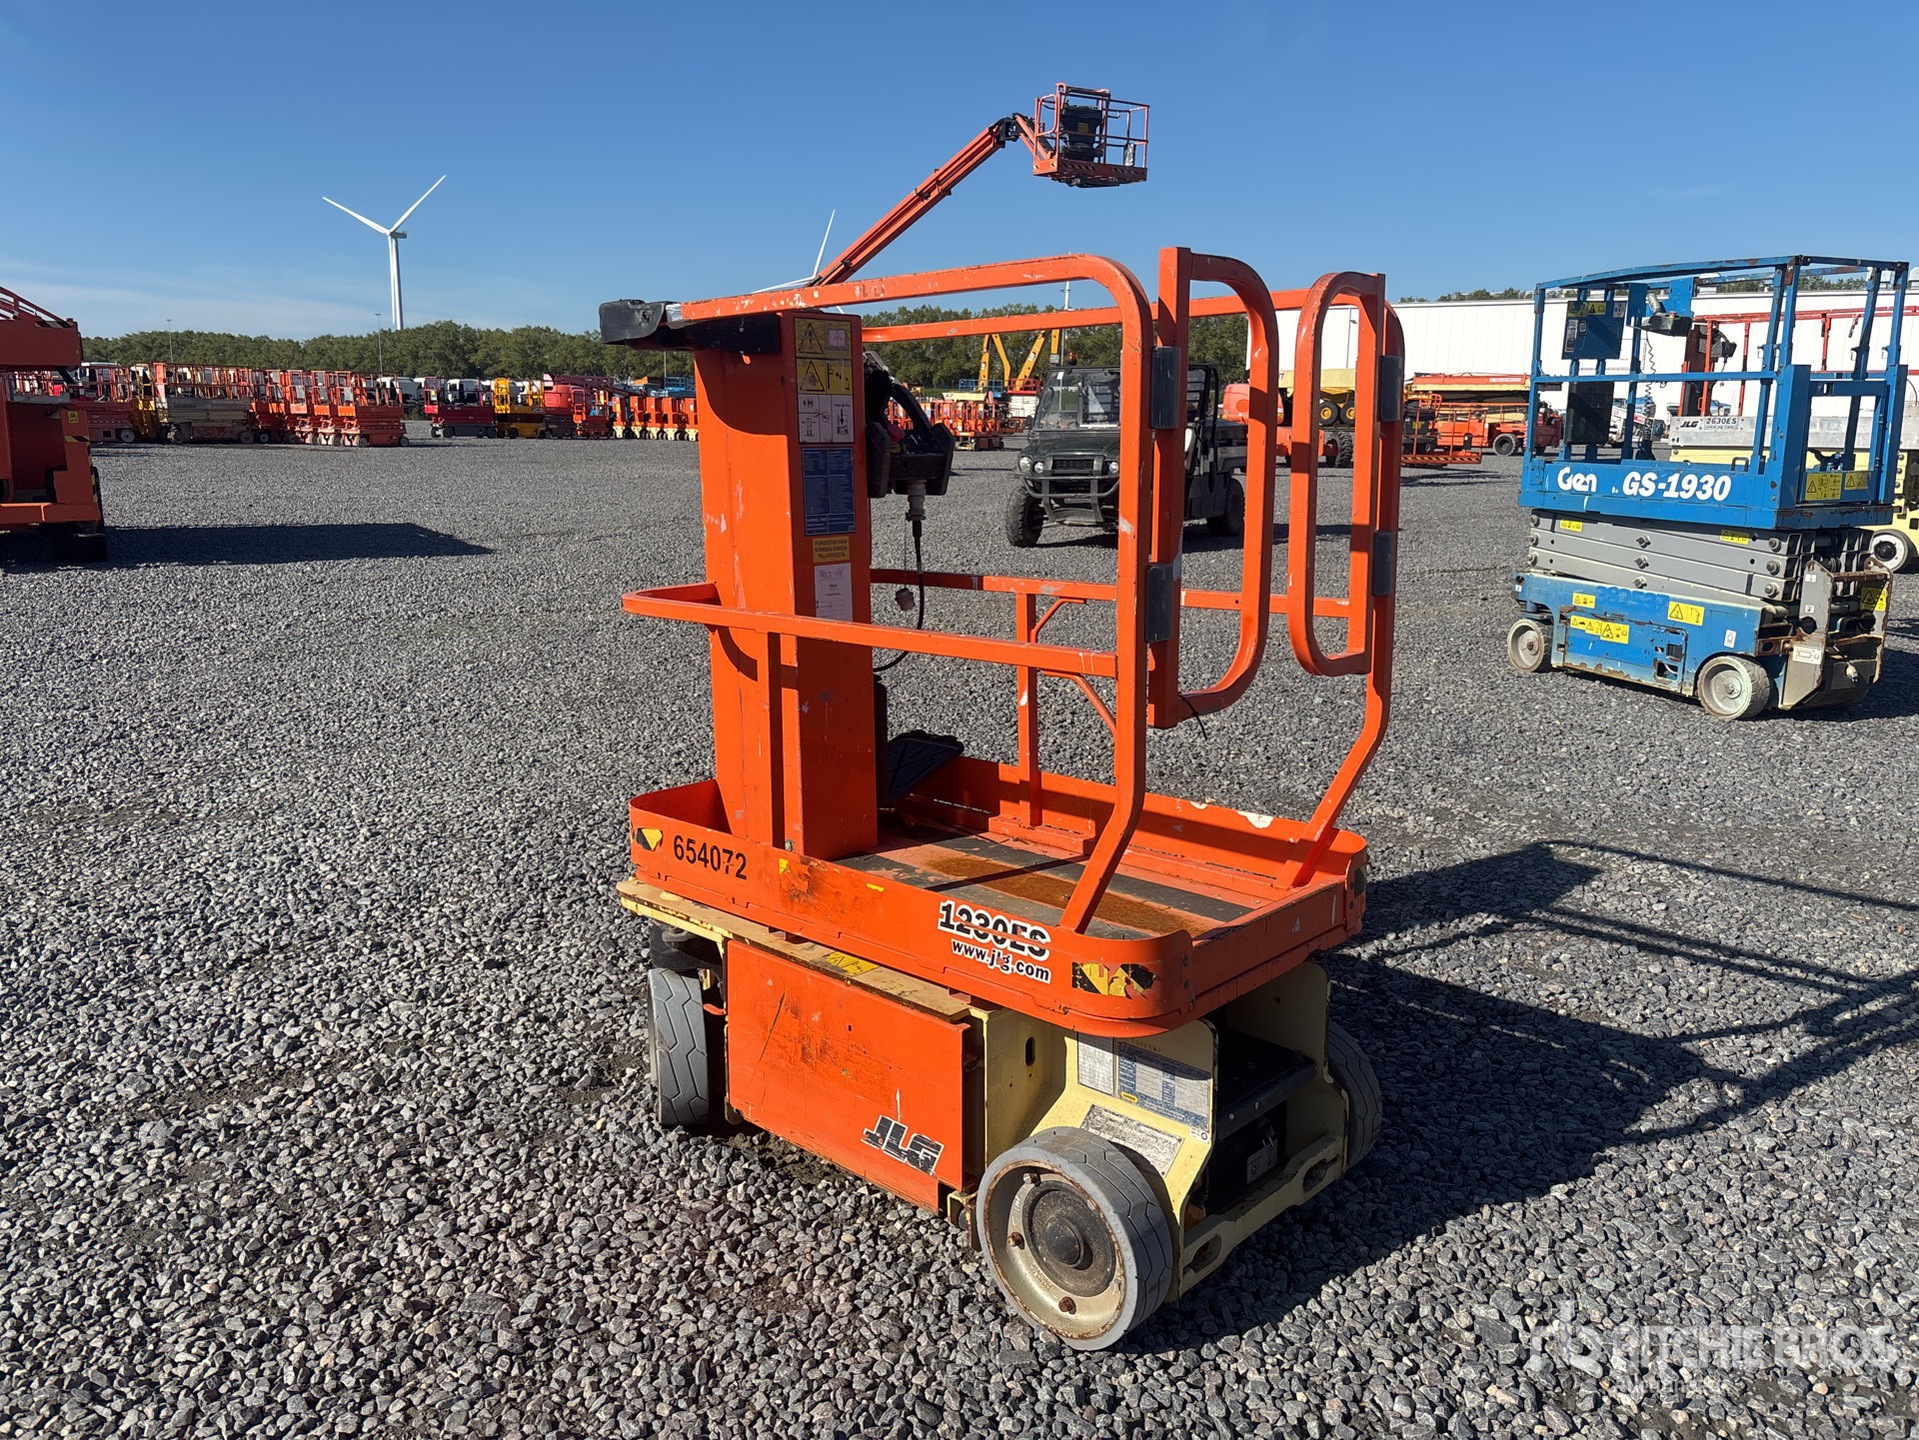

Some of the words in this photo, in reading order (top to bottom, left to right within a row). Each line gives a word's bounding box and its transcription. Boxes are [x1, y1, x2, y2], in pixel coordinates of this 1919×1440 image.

[1680, 420, 1699, 428] JLG
[1706, 417, 1737, 425] 2630ES
[1622, 471, 1732, 501] GS-1930
[673, 834, 747, 881] 654072
[939, 901, 1049, 960] 1230ES
[952, 939, 1050, 983] www.jlg.com
[861, 1115, 944, 1176] JLG
